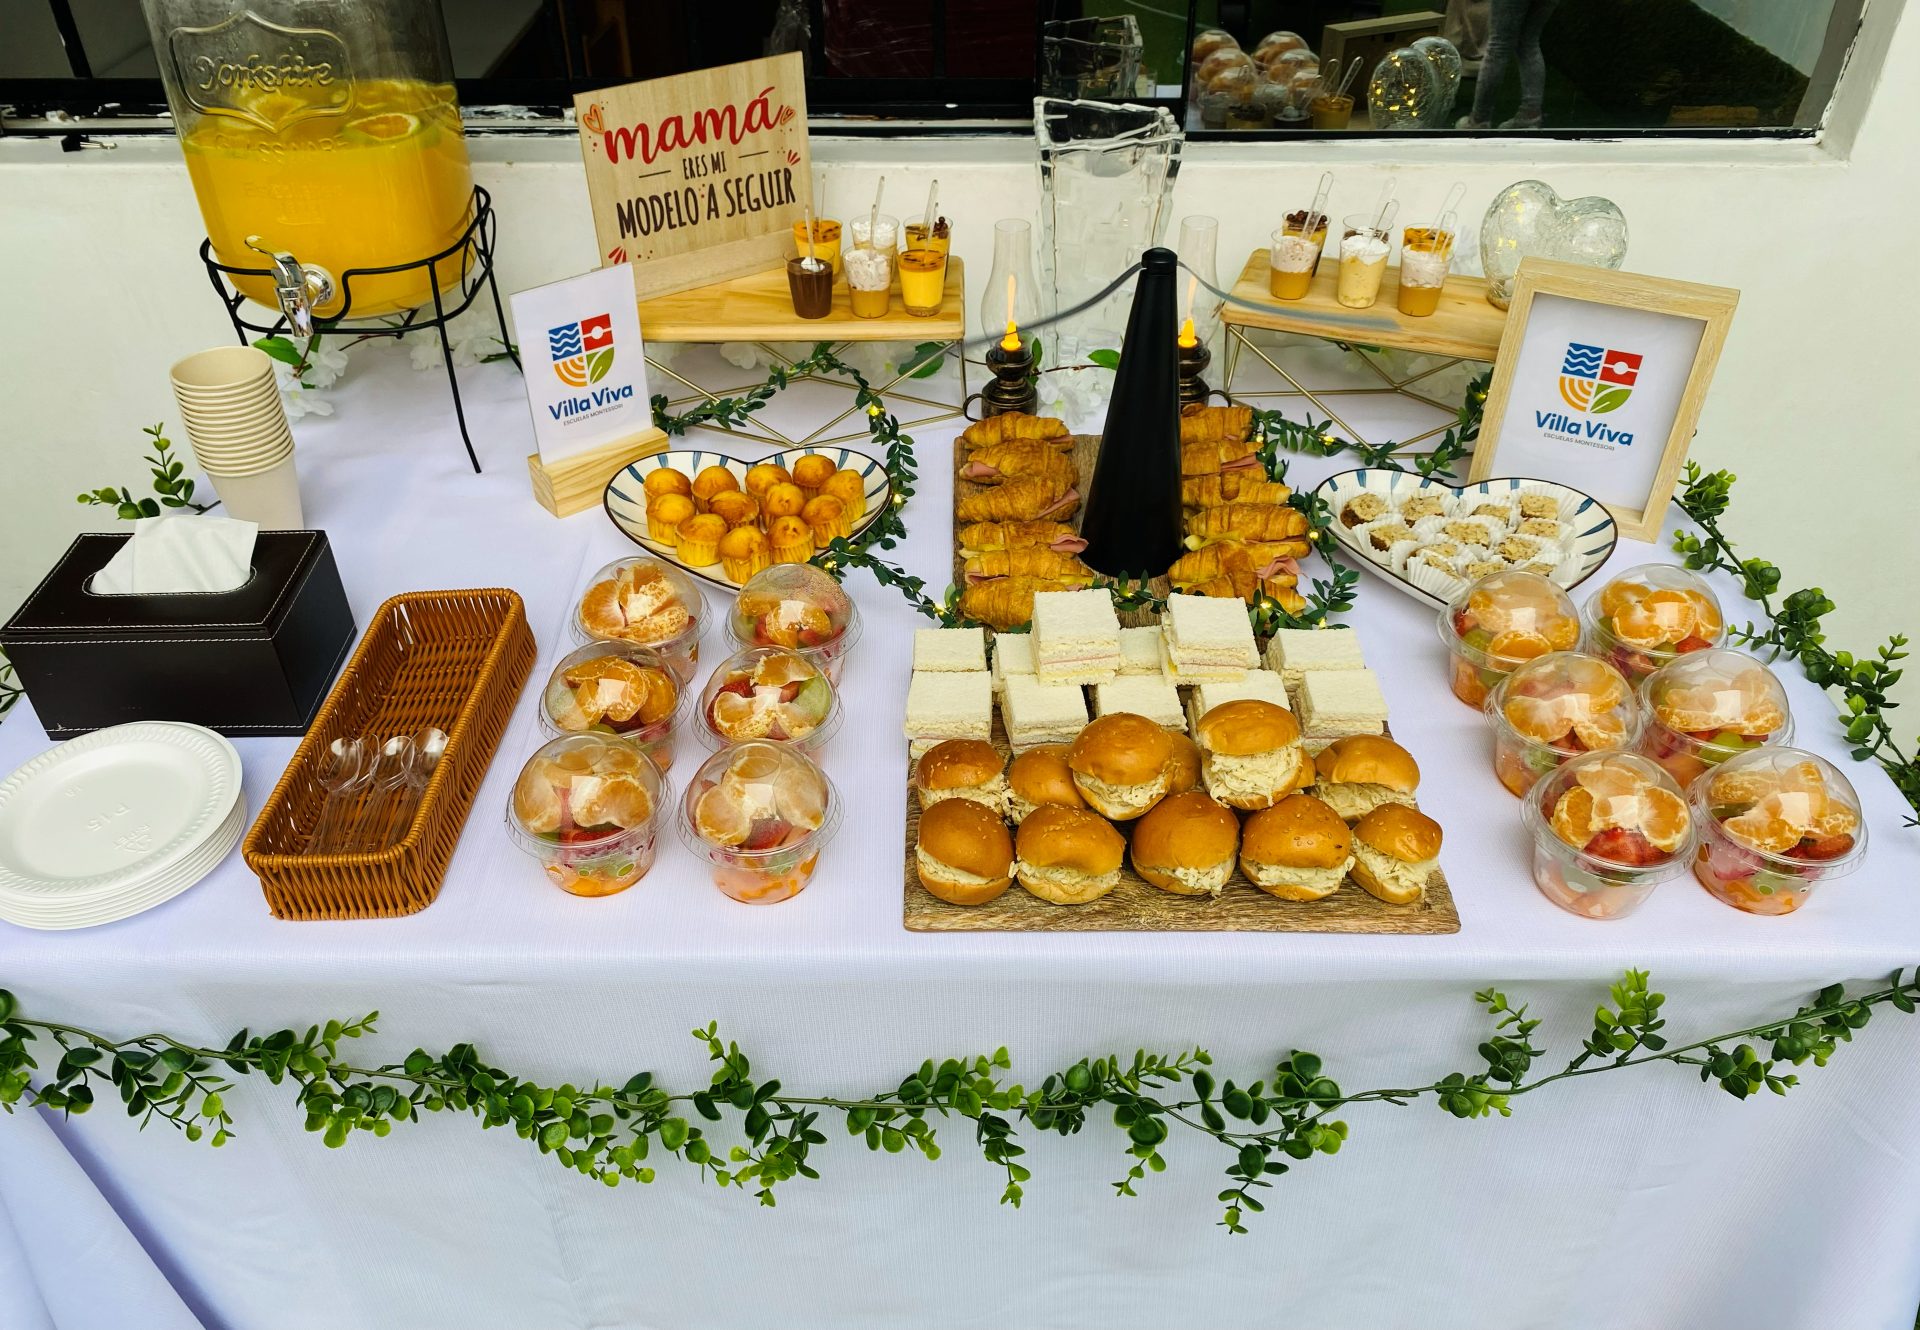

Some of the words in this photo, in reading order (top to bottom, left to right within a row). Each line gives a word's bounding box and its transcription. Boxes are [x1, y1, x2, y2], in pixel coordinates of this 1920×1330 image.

[604, 86, 783, 164] mamá
[683, 155, 708, 180] ERES
[712, 150, 727, 174] MI
[616, 186, 699, 240] MODELO
[706, 183, 720, 221] A
[723, 167, 796, 218] SEGUIR
[548, 397, 591, 420] Villa
[592, 384, 633, 407] Viva
[563, 413, 590, 426] ESCUELAS
[590, 403, 624, 418] MONTESSORI
[1536, 410, 1581, 435] Villa
[1585, 420, 1634, 446] Viva
[1543, 432, 1574, 443] ESCUELAS
[1574, 438, 1615, 451] MONTESSORI
